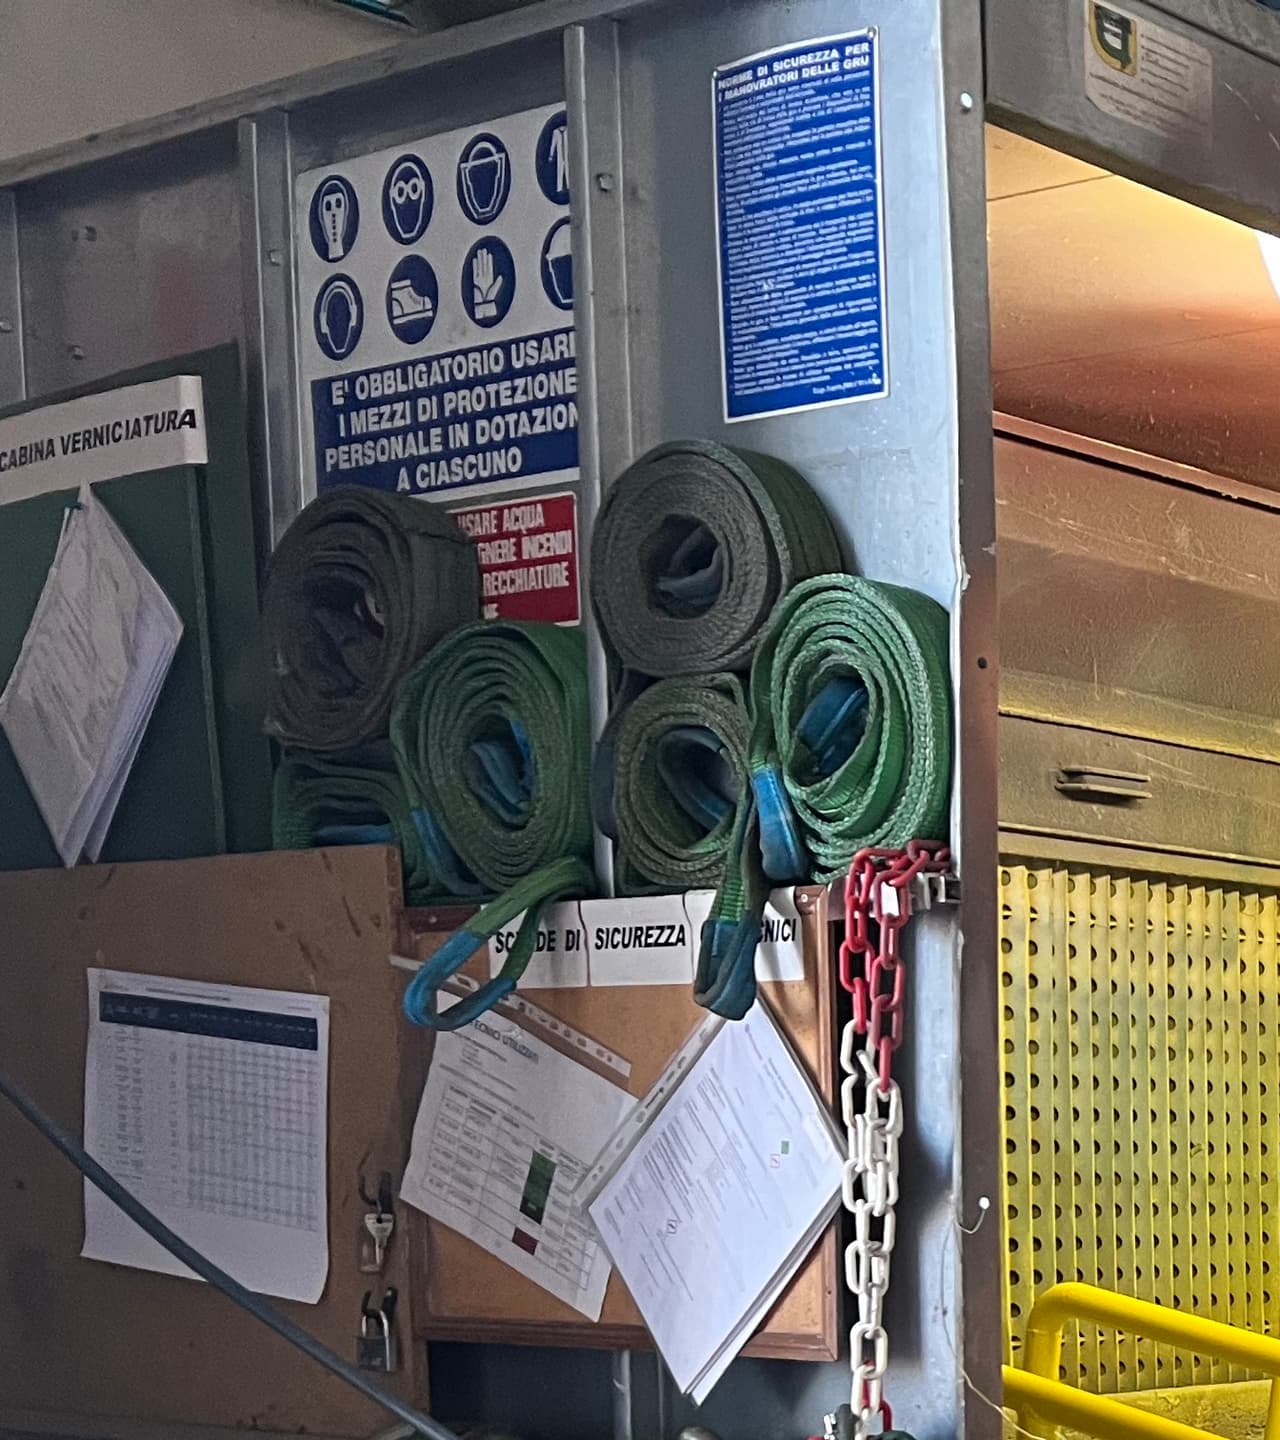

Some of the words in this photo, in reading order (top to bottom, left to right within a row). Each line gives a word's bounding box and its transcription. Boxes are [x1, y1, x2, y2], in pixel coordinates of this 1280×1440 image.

[718, 70, 752, 89] NORME
[757, 66, 768, 77] DI
[773, 49, 839, 72] SICUREZZA
[845, 42, 870, 56] PER
[725, 71, 798, 99] MANOVRATORI
[802, 62, 839, 78] DELLE
[843, 55, 869, 69] GRU
[355, 347, 504, 401] OBBLIGATORIO
[339, 414, 345, 437] I
[351, 400, 411, 434] MEZZI
[417, 396, 437, 420] DI
[444, 367, 577, 417] PROTEZIONE
[0, 438, 55, 472] CABINA
[60, 409, 196, 455] VERNICIATURA
[325, 427, 442, 472] PERSONALE
[449, 423, 469, 448] IN
[476, 402, 578, 445] DOTAZION
[396, 466, 410, 492] A
[416, 446, 522, 489] CIASCUNO
[503, 503, 545, 534] ACQUA
[483, 561, 569, 597] RECCHIATURE
[495, 930, 557, 954] SCDE
[565, 929, 581, 951] DI
[594, 924, 687, 950] SICUREZZA
